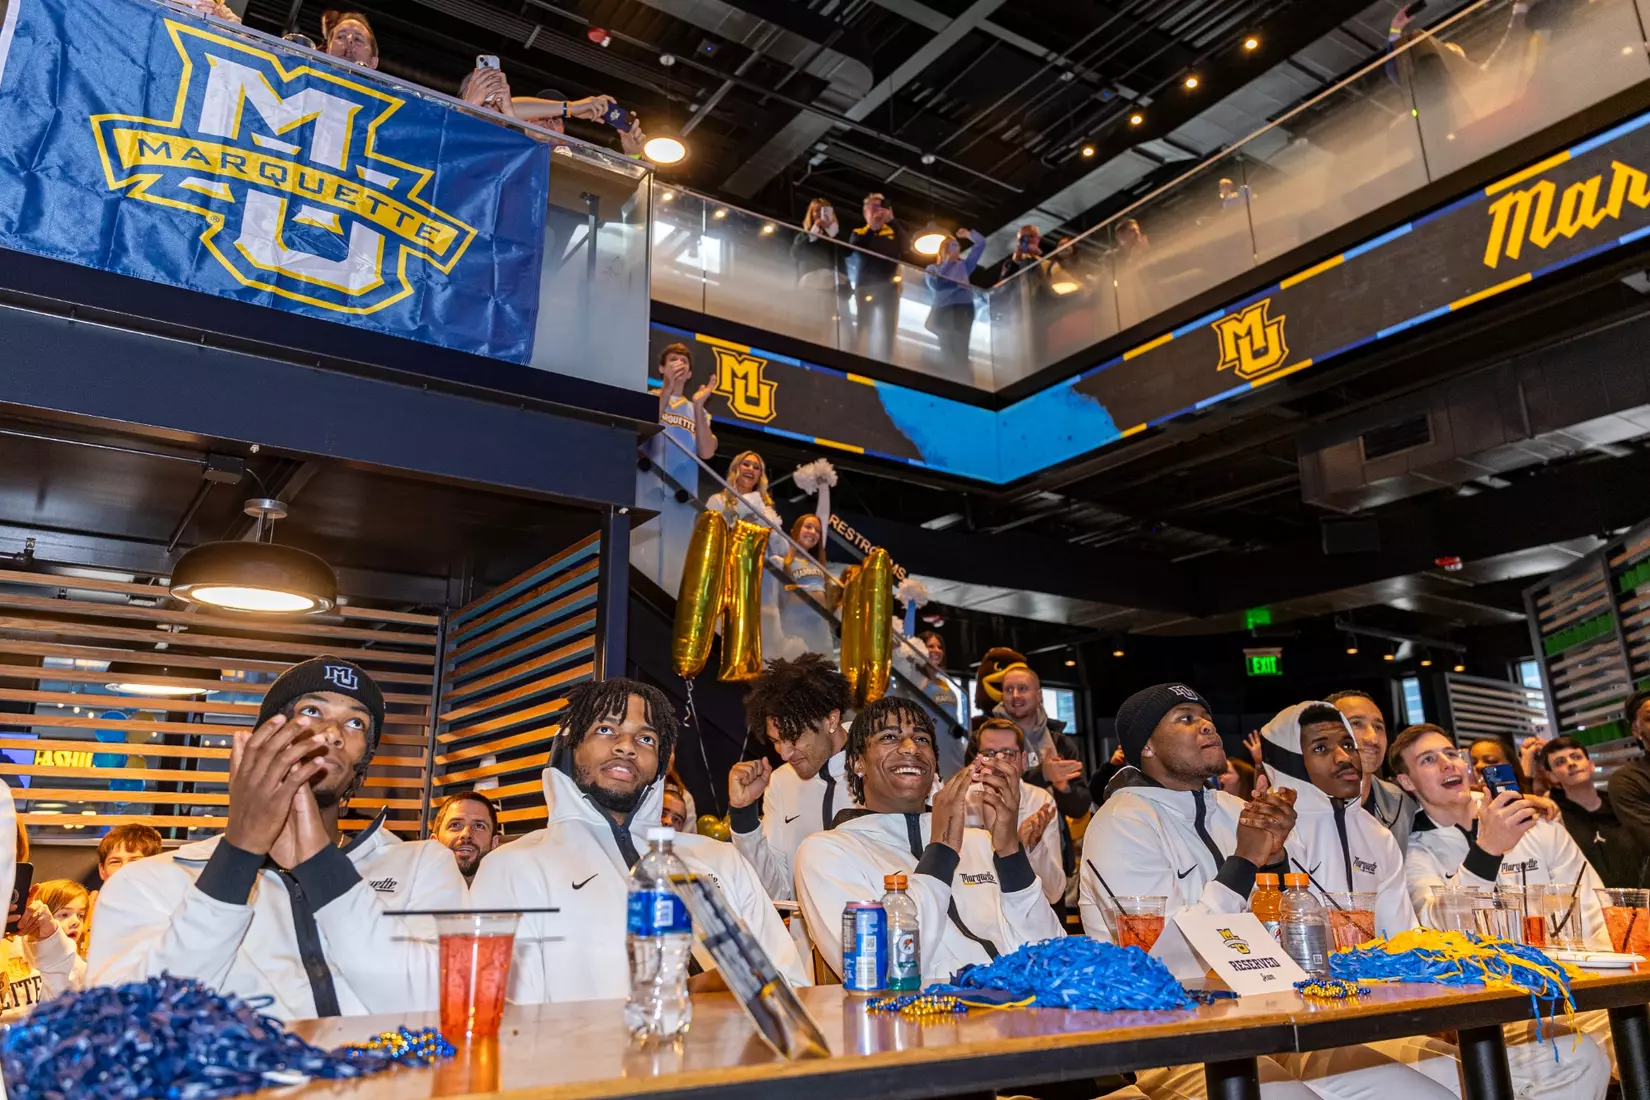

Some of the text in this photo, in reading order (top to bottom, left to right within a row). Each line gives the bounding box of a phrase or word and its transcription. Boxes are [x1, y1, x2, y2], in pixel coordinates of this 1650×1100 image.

[138, 139, 440, 246] MARQUETTE
[1214, 301, 1286, 377] MU
[715, 349, 776, 421] MU
[1252, 656, 1277, 673] EXIT
[1501, 858, 1537, 872] Marqette
[1228, 957, 1281, 971] RESERVED
